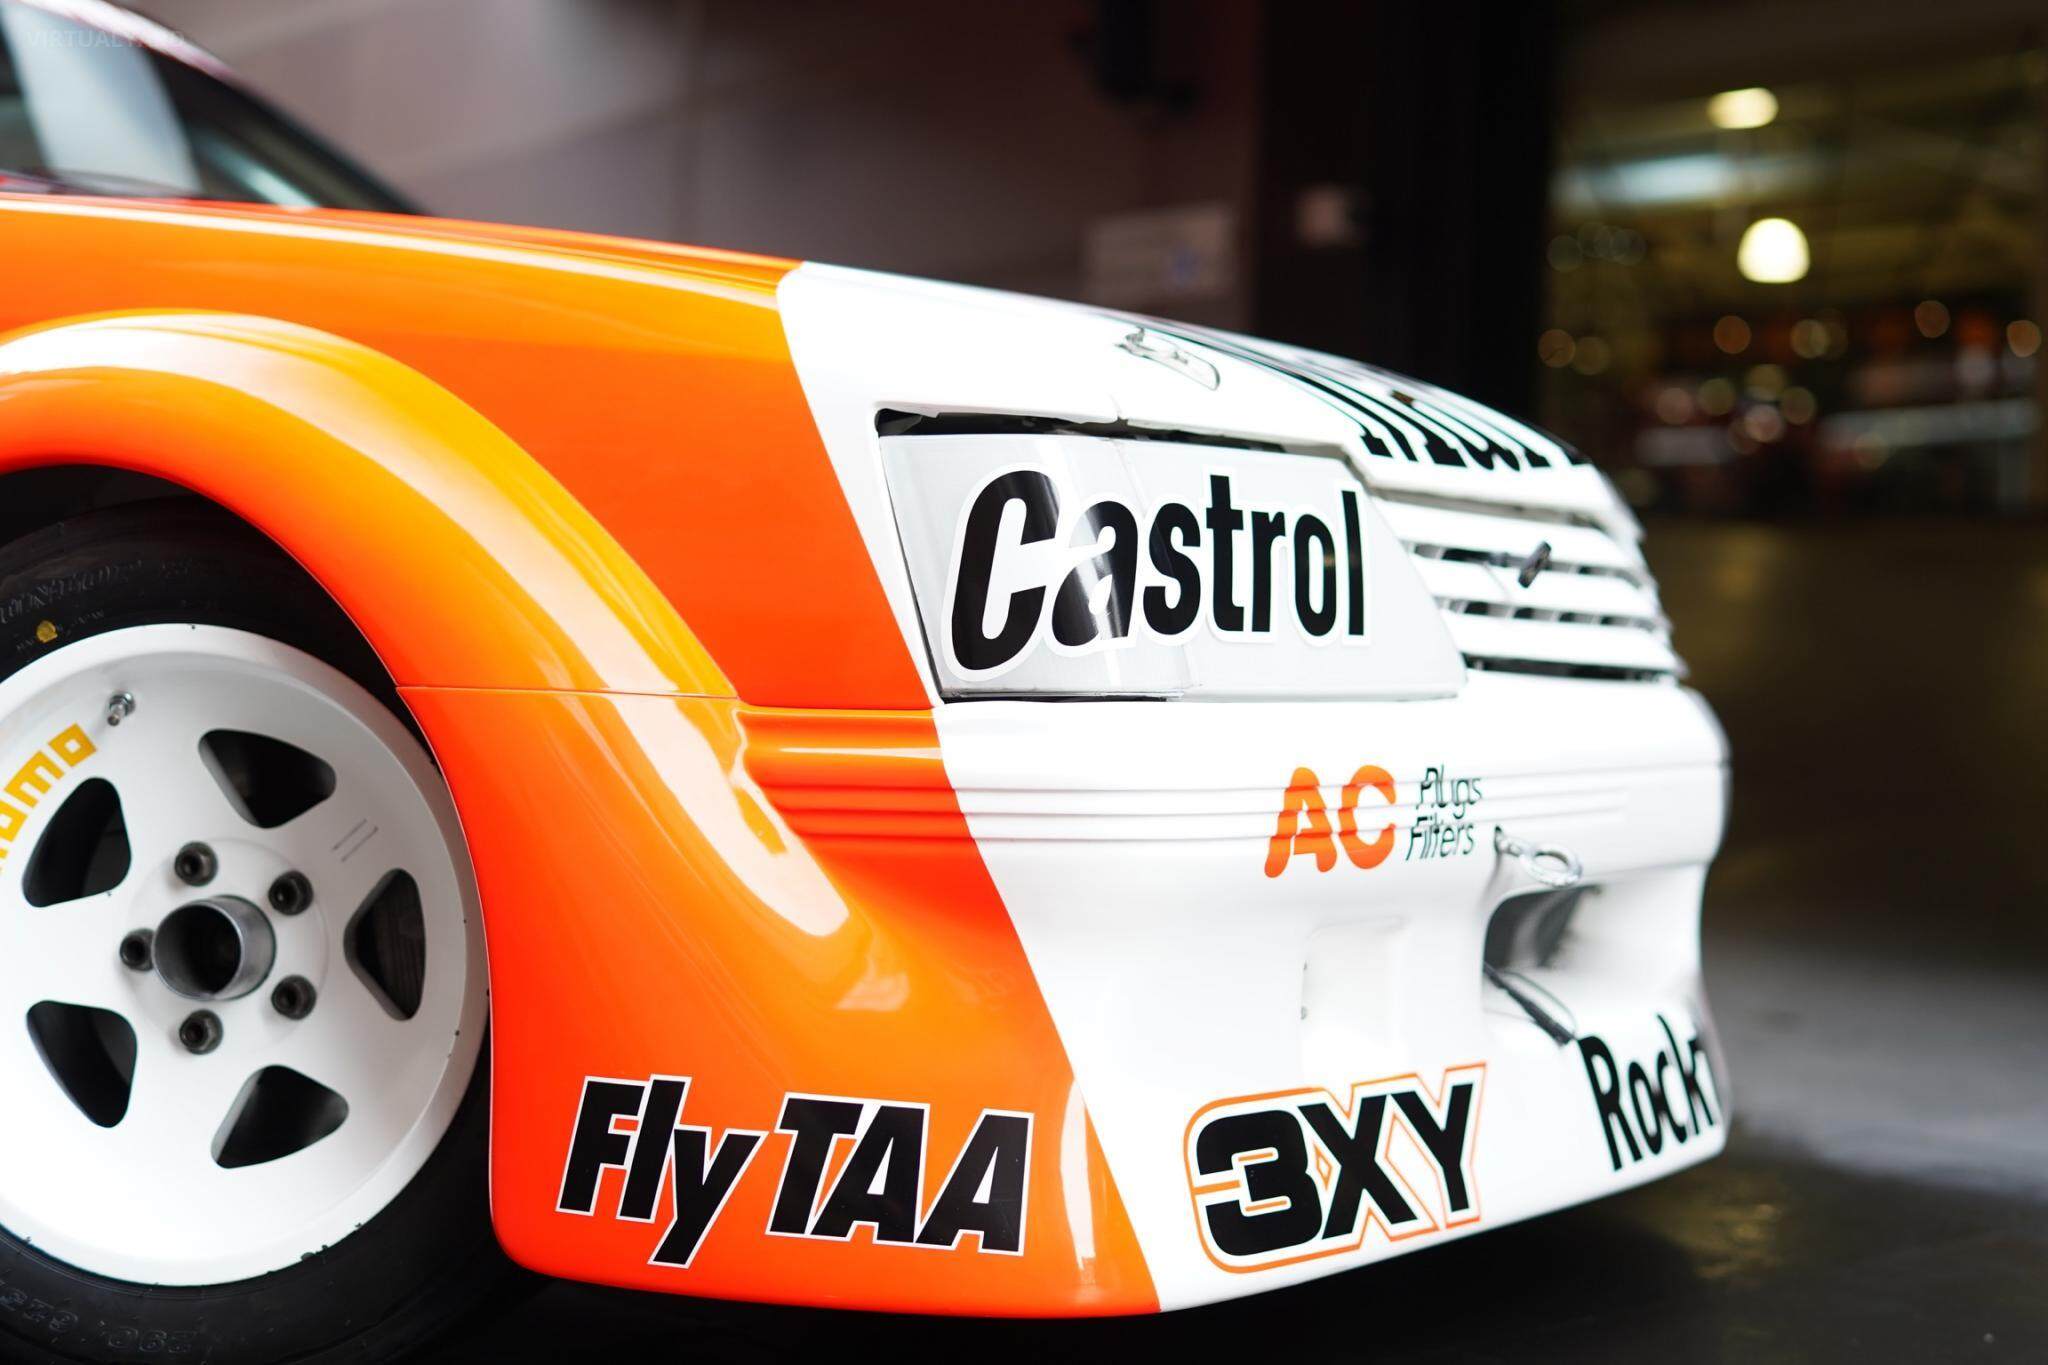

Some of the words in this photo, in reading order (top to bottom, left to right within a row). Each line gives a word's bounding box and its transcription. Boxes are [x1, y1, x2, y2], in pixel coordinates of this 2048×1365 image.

[950, 469, 1366, 672] Castrol
[0, 721, 98, 877] omo
[1263, 764, 1396, 878] AC
[1404, 812, 1475, 861] Filters
[1414, 763, 1483, 820] Plugs
[1190, 1072, 1480, 1264] 3XY
